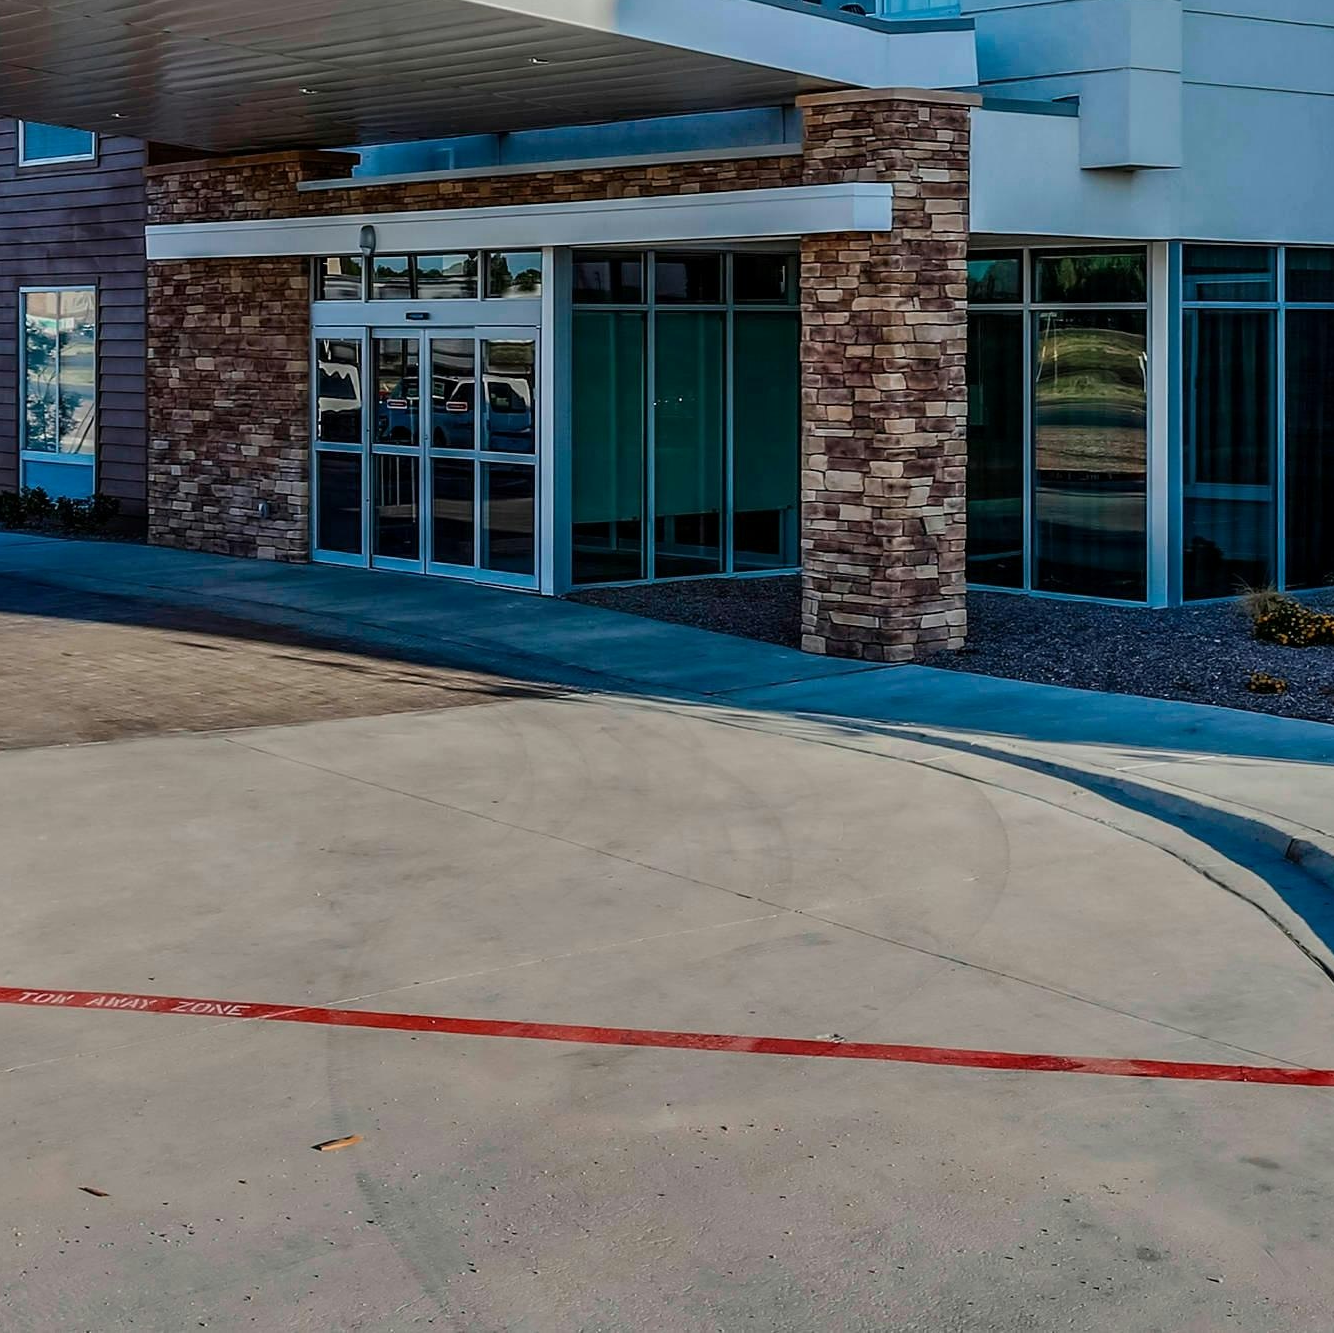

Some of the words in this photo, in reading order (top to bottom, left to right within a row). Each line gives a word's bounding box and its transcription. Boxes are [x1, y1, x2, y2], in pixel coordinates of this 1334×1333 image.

[18, 991, 75, 1005] TOW
[85, 995, 158, 1010] AWAY
[171, 1001, 252, 1016] ZONE
